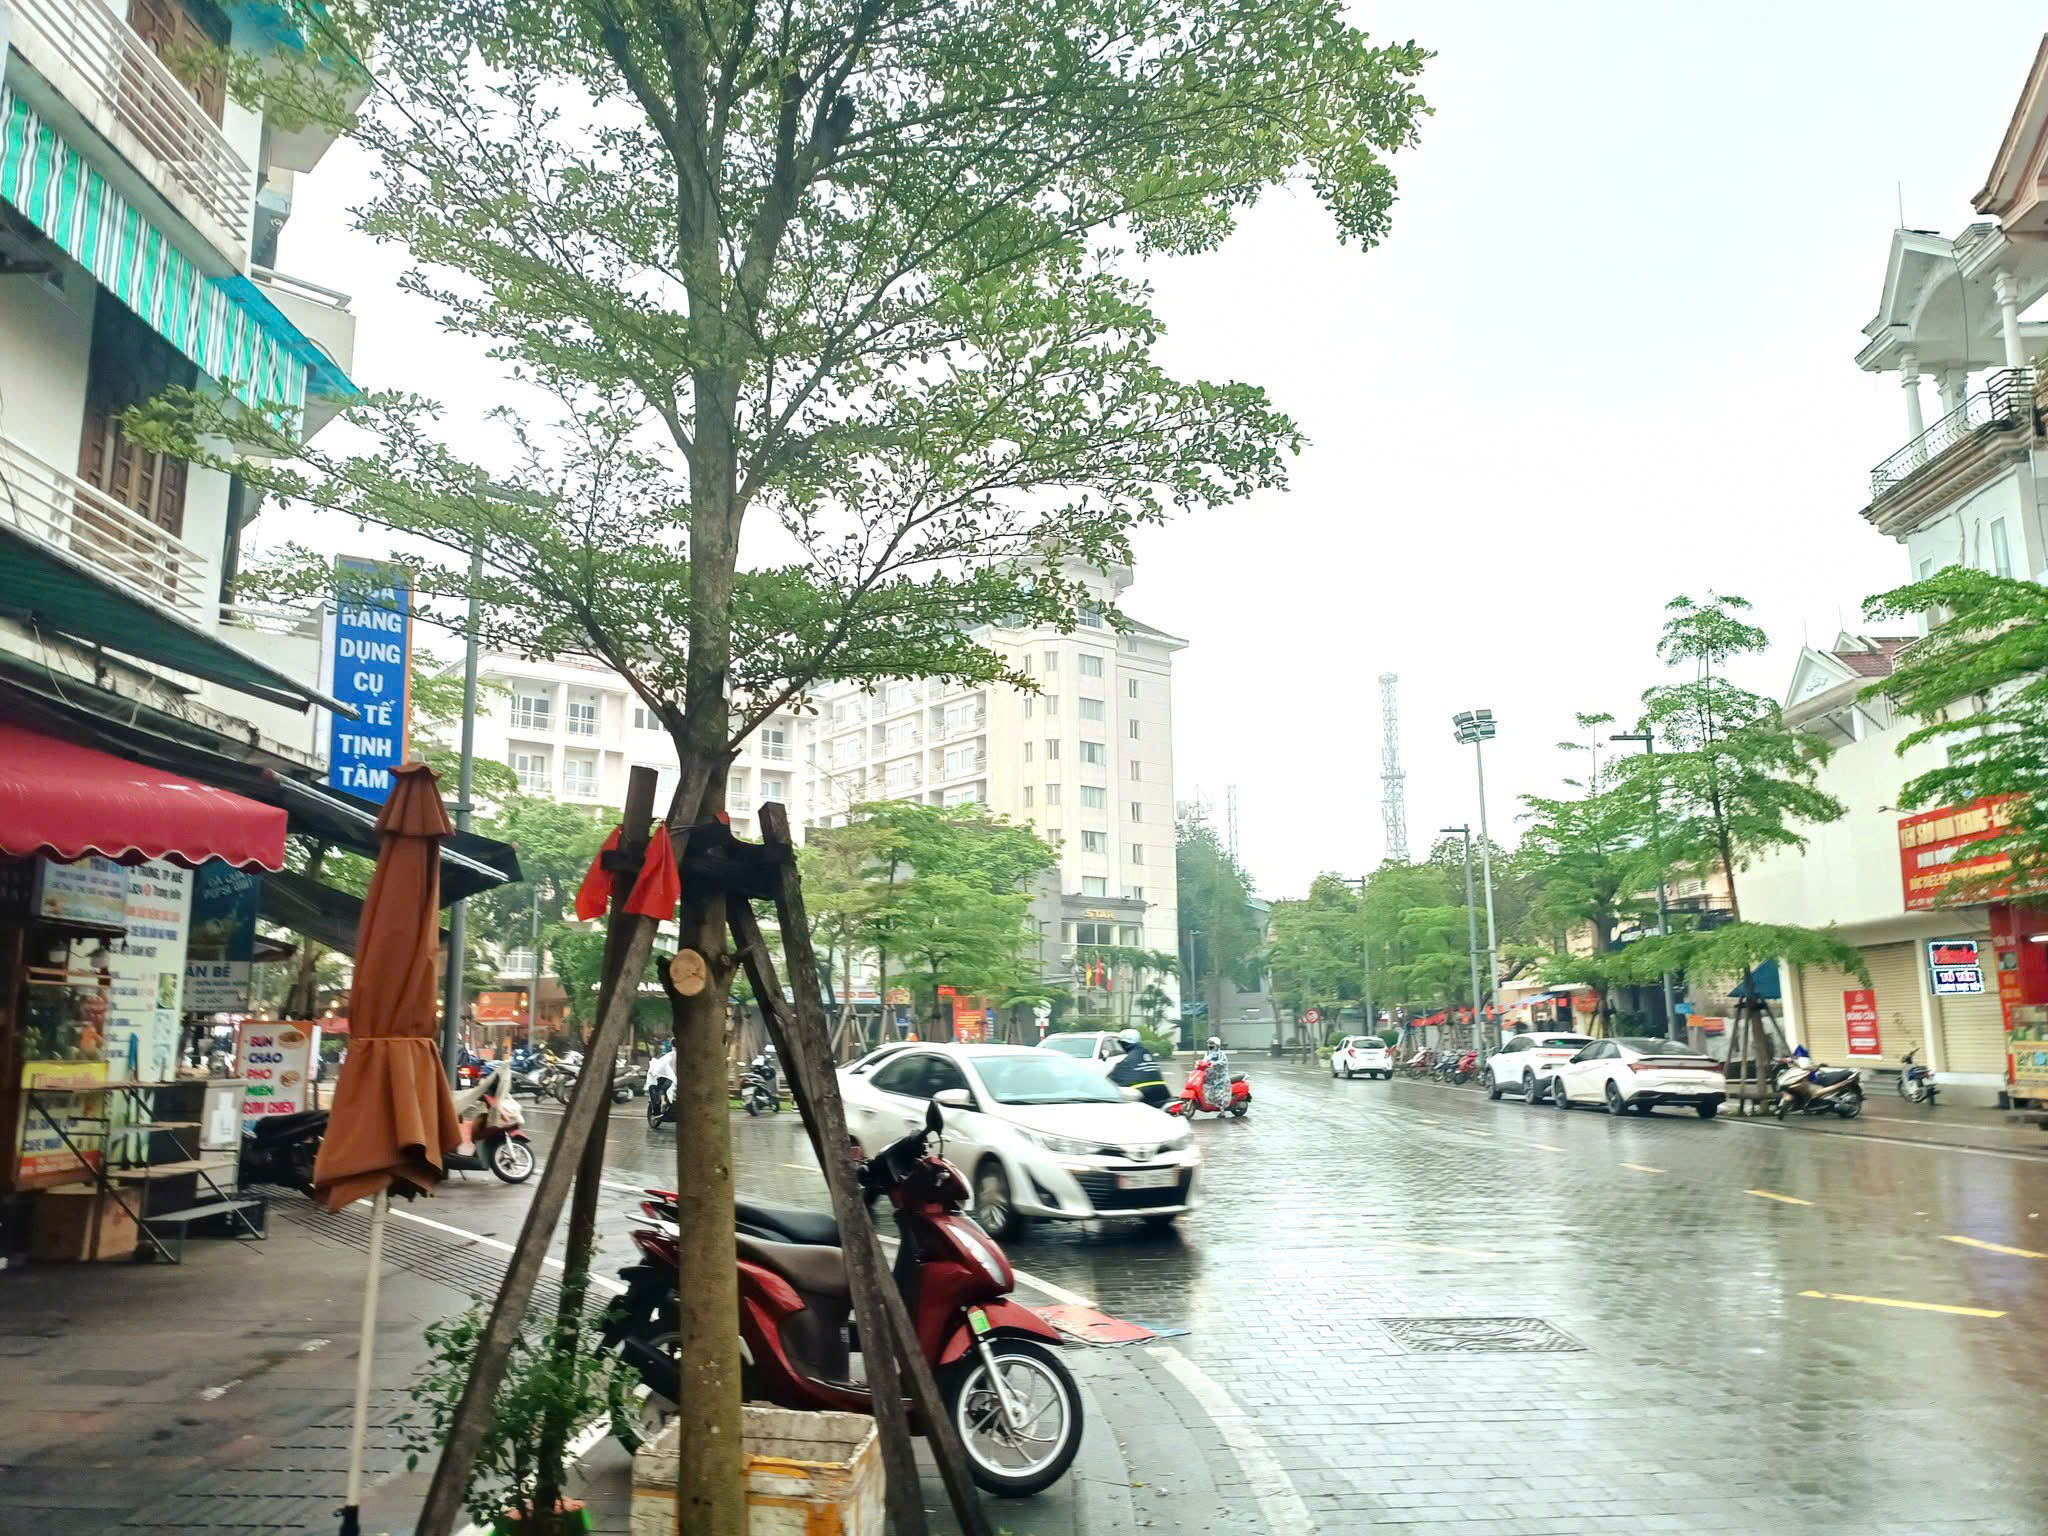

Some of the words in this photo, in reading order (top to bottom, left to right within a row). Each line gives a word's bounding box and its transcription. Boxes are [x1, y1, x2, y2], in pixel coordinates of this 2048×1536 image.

[340, 638, 401, 665] DỤNG
[353, 671, 384, 697] CỤ
[363, 699, 396, 727] TẾ
[339, 733, 392, 760] TỊNH
[339, 763, 389, 790] TÂM
